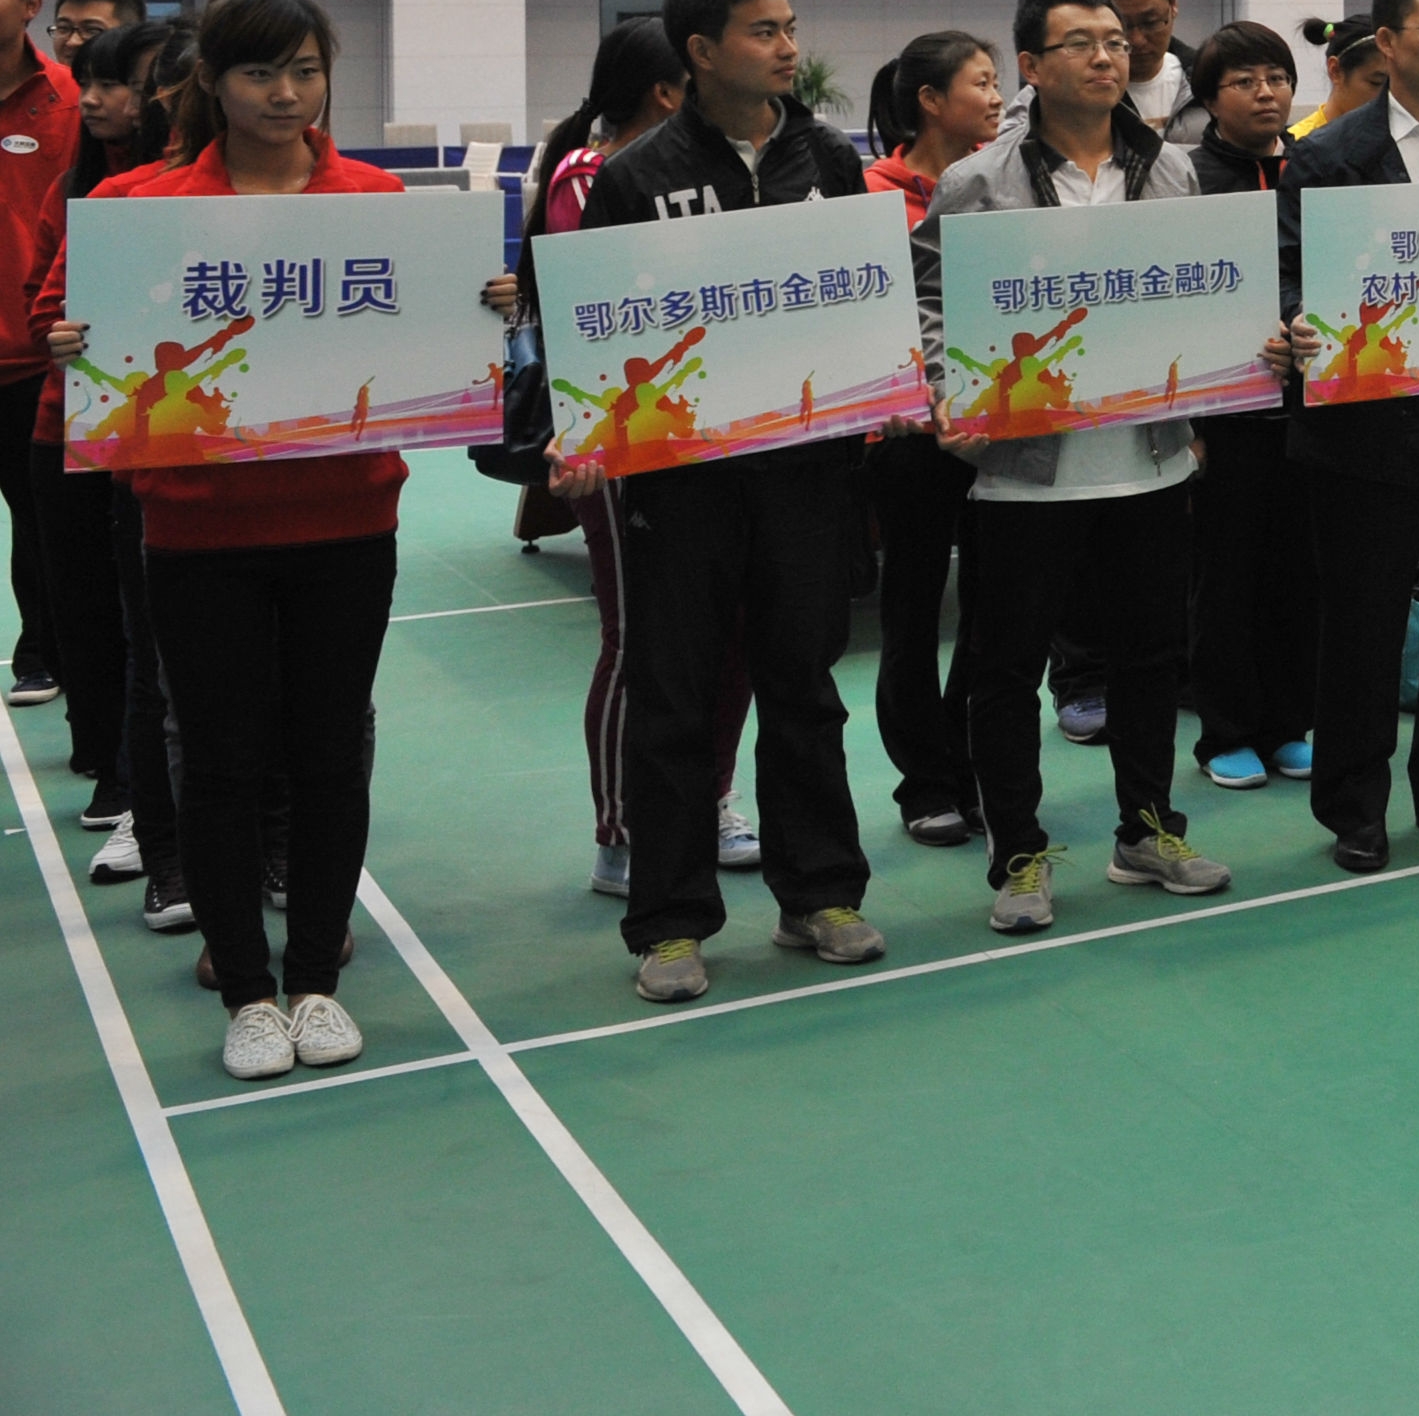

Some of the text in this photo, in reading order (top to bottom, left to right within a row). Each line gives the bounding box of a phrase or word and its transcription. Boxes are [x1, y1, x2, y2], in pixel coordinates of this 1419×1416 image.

[183, 257, 397, 318] 裁判员
[574, 262, 892, 339] 鄂尔多斯市金融办
[992, 259, 1240, 311] 鄂托克旗金融办
